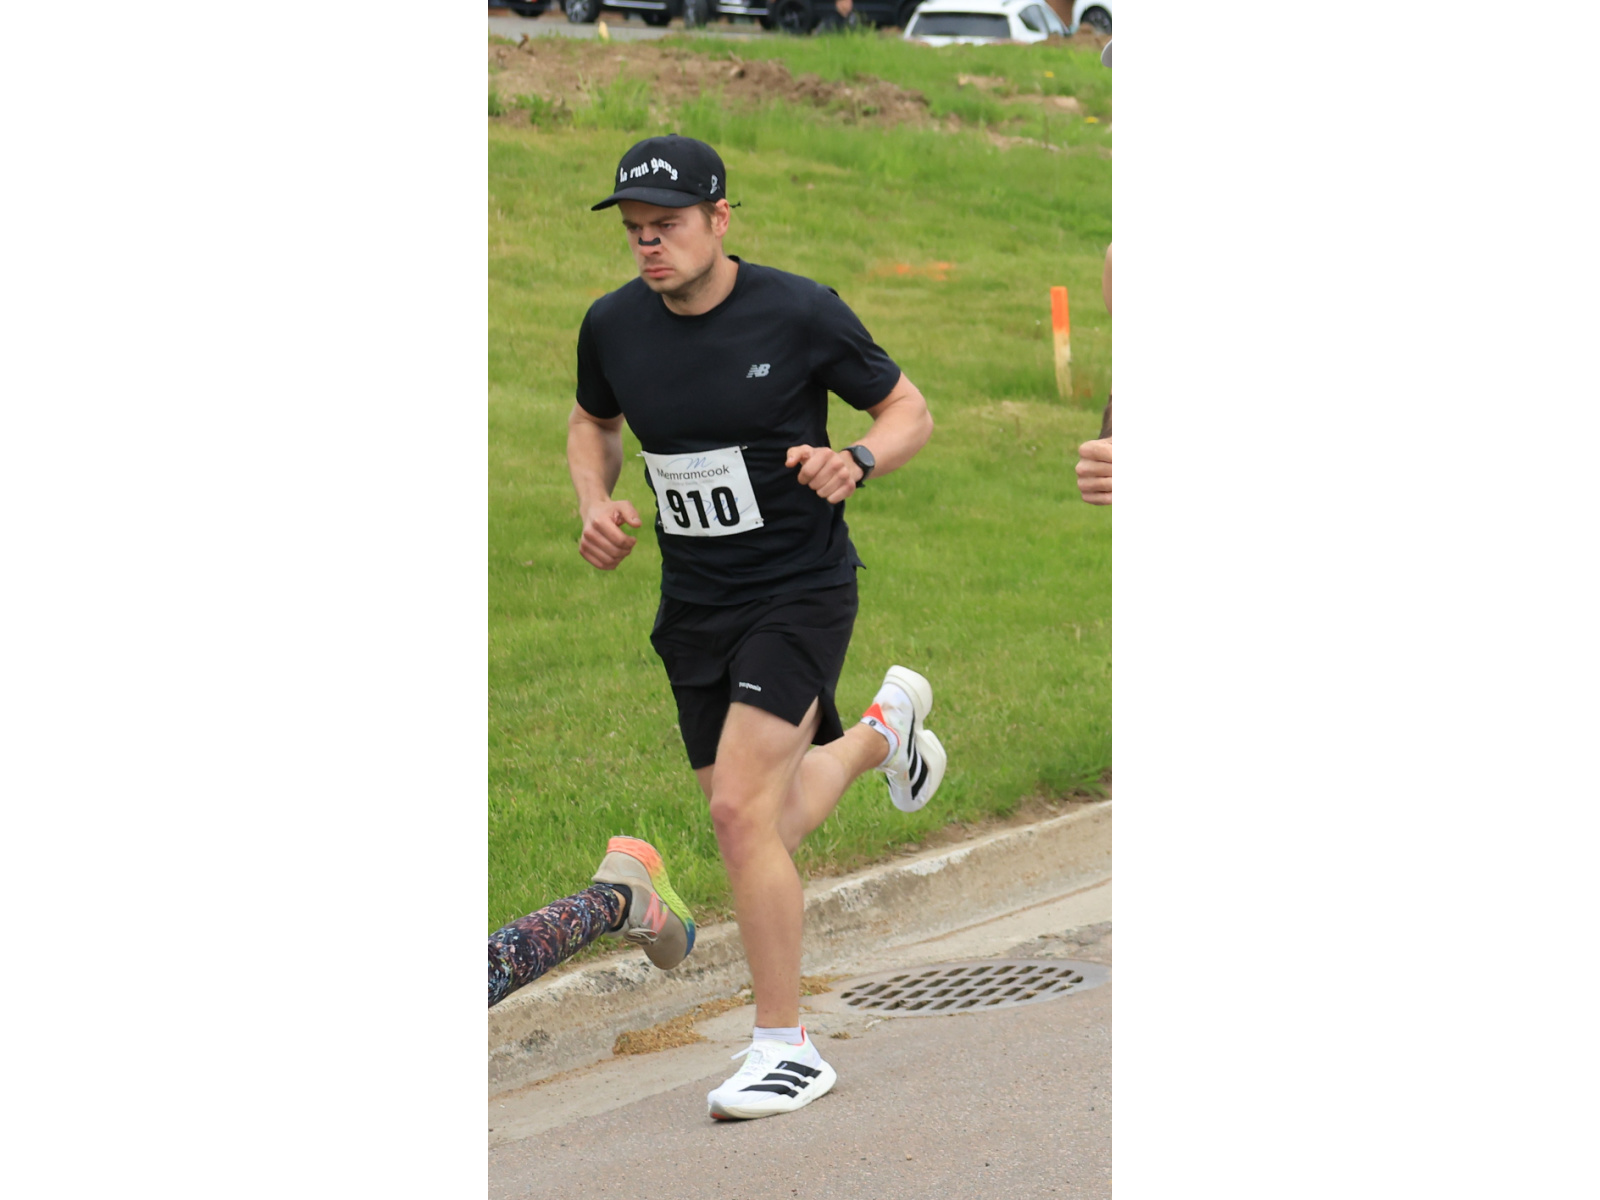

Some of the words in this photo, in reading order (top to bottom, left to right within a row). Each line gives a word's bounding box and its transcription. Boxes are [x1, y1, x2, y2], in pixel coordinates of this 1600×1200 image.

[629, 161, 650, 179] run
[650, 157, 678, 181] gang
[656, 464, 730, 481] Memramcook
[665, 486, 740, 529] 910
